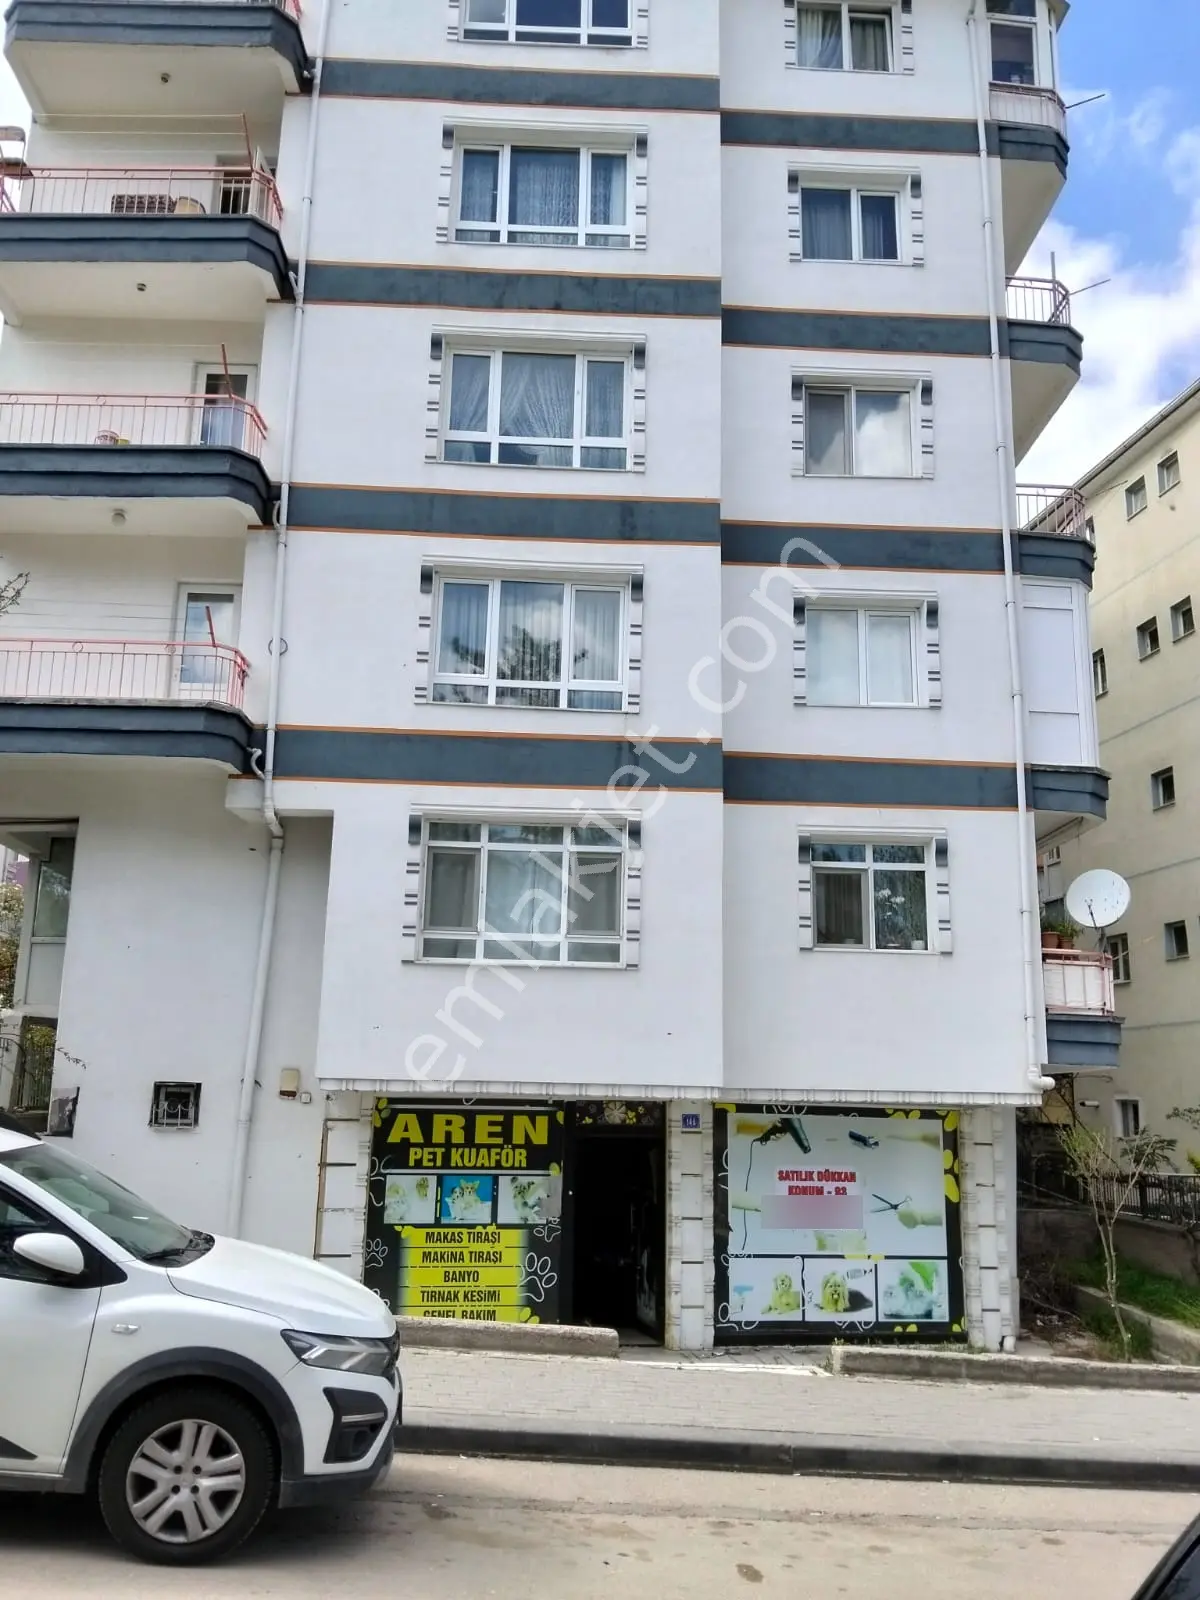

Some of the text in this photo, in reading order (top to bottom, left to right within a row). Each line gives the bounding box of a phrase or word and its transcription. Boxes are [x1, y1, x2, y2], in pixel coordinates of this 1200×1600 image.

[386, 1113, 548, 1145] AREN
[408, 1145, 527, 1168] PET KUAFÖR
[778, 1168, 857, 1183] SATILIK DÜKKAN
[425, 1231, 501, 1245] MAKAS TIRAŞI
[422, 1250, 503, 1265] MAKİNA TIRAŞI
[443, 1270, 480, 1283] BANYO
[420, 1290, 501, 1303] TIRNAK KESİMİ
[461, 1309, 497, 1321] BAKIM
